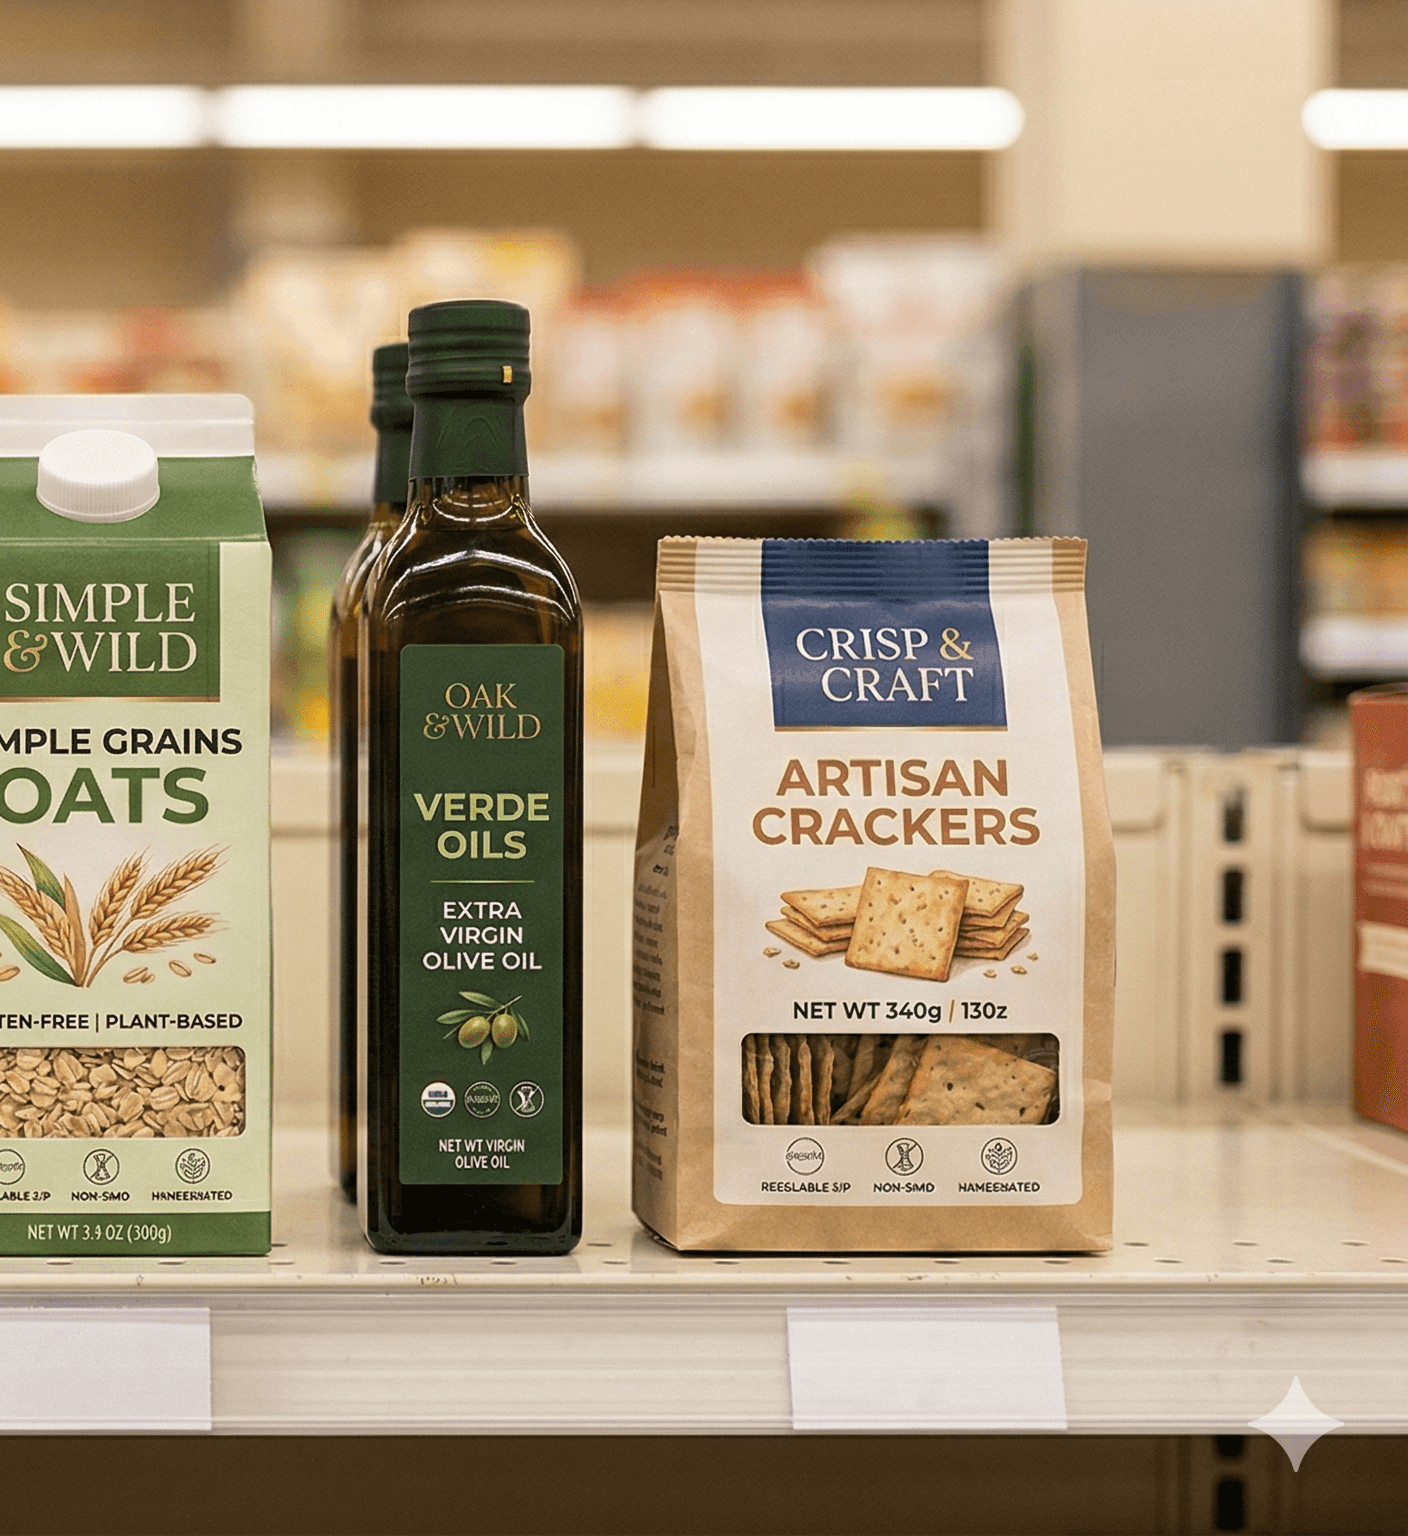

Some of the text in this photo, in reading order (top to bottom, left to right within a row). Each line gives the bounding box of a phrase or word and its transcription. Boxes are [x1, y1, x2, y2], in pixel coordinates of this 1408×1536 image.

[5, 582, 196, 623] SIMPLE
[3, 629, 197, 673] &WILD
[796, 627, 975, 661] CRISP &
[445, 682, 517, 709] OAK
[821, 666, 974, 702] CRAFT
[423, 712, 541, 740] &WILD
[102, 728, 243, 755] GRAINS
[775, 758, 1009, 797] ARTISAN
[413, 792, 550, 822] VERDE
[752, 807, 1041, 846] CRACKERS
[437, 830, 527, 860] OILS
[443, 901, 523, 920] EXTRA
[439, 926, 523, 945] VIRGIN
[422, 951, 543, 970] OLIVE OIL
[106, 1013, 243, 1029] PLANT-BASED
[793, 1001, 837, 1020] NET
[842, 1001, 881, 1020] WT
[885, 1001, 942, 1024] 340g
[438, 1138, 525, 1153] NET WT VIRGIN
[454, 1154, 511, 1169] OLIVE OIL
[27, 1224, 54, 1240] NET
[57, 1224, 79, 1240] WT
[105, 1223, 124, 1241] OZ
[127, 1224, 172, 1245] (300g)
